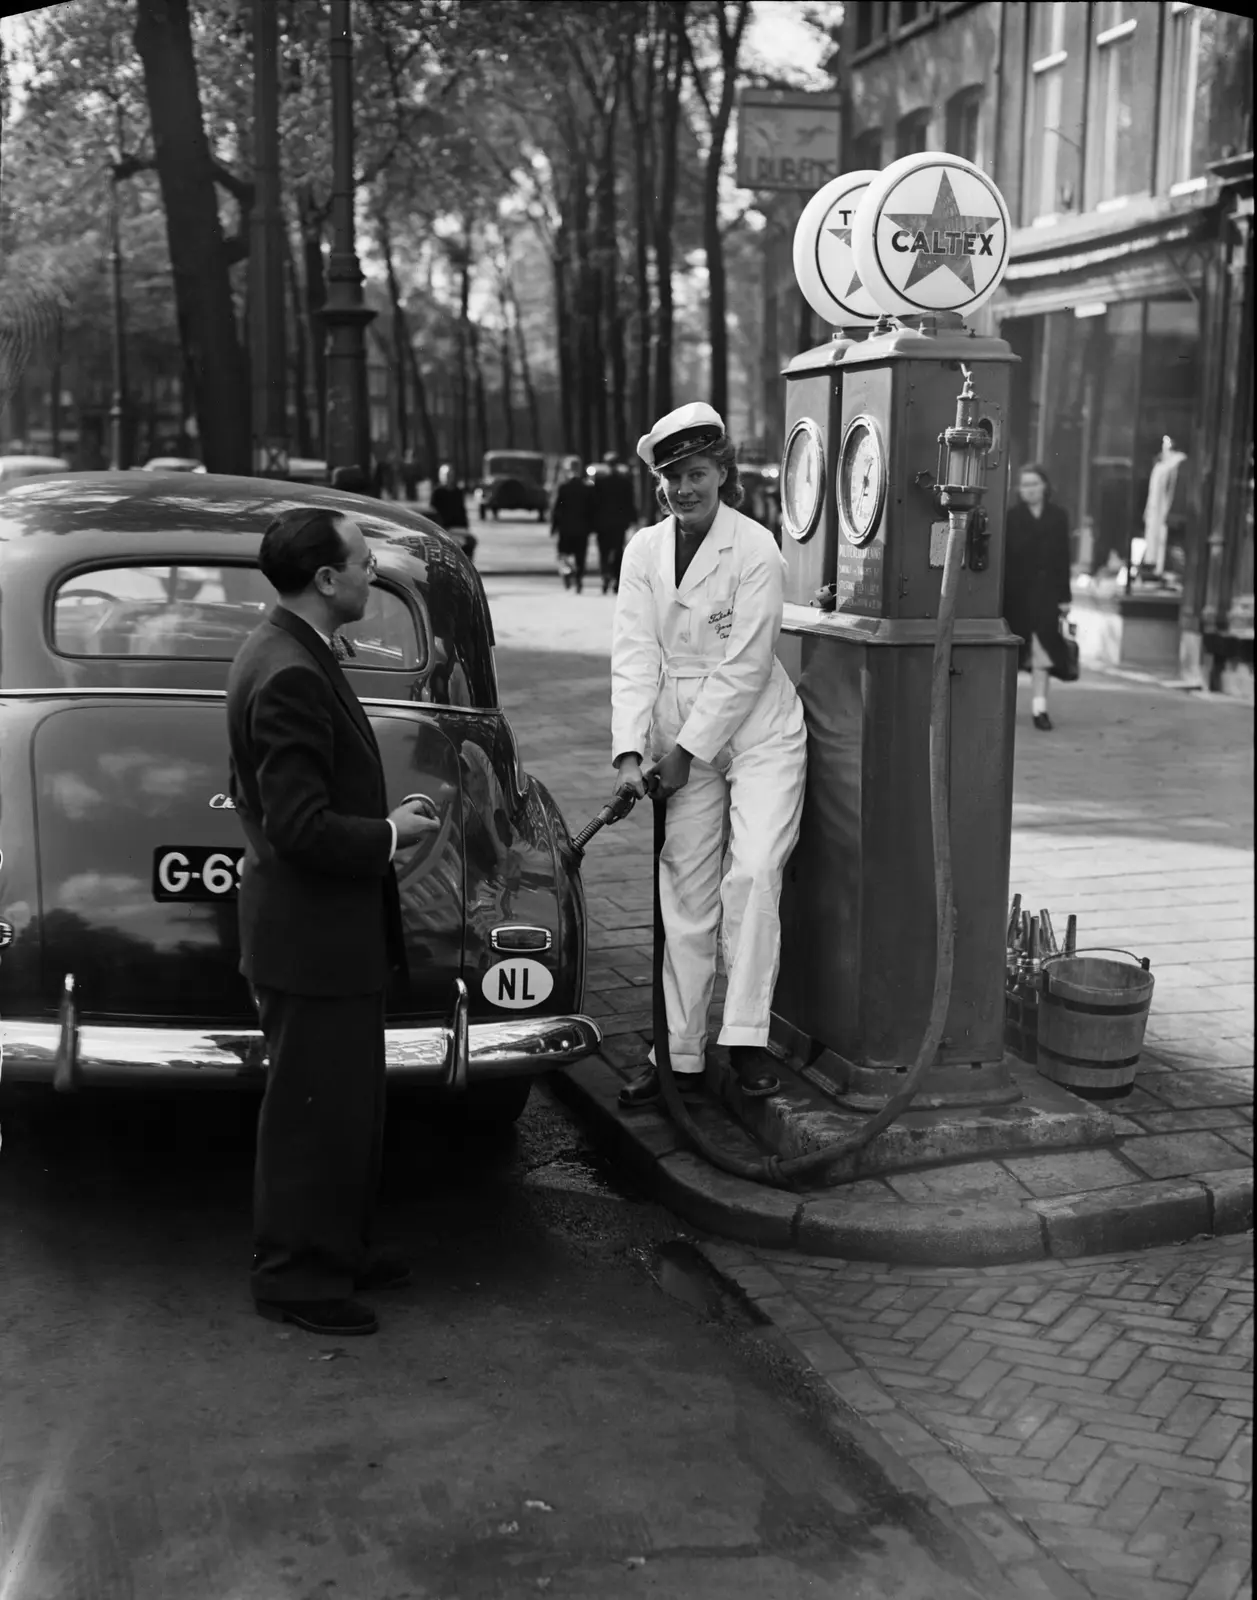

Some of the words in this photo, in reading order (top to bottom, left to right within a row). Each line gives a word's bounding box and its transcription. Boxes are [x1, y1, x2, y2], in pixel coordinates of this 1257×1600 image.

[838, 210, 857, 226] T
[891, 230, 994, 256] CALTEX
[498, 968, 535, 1001] NL
